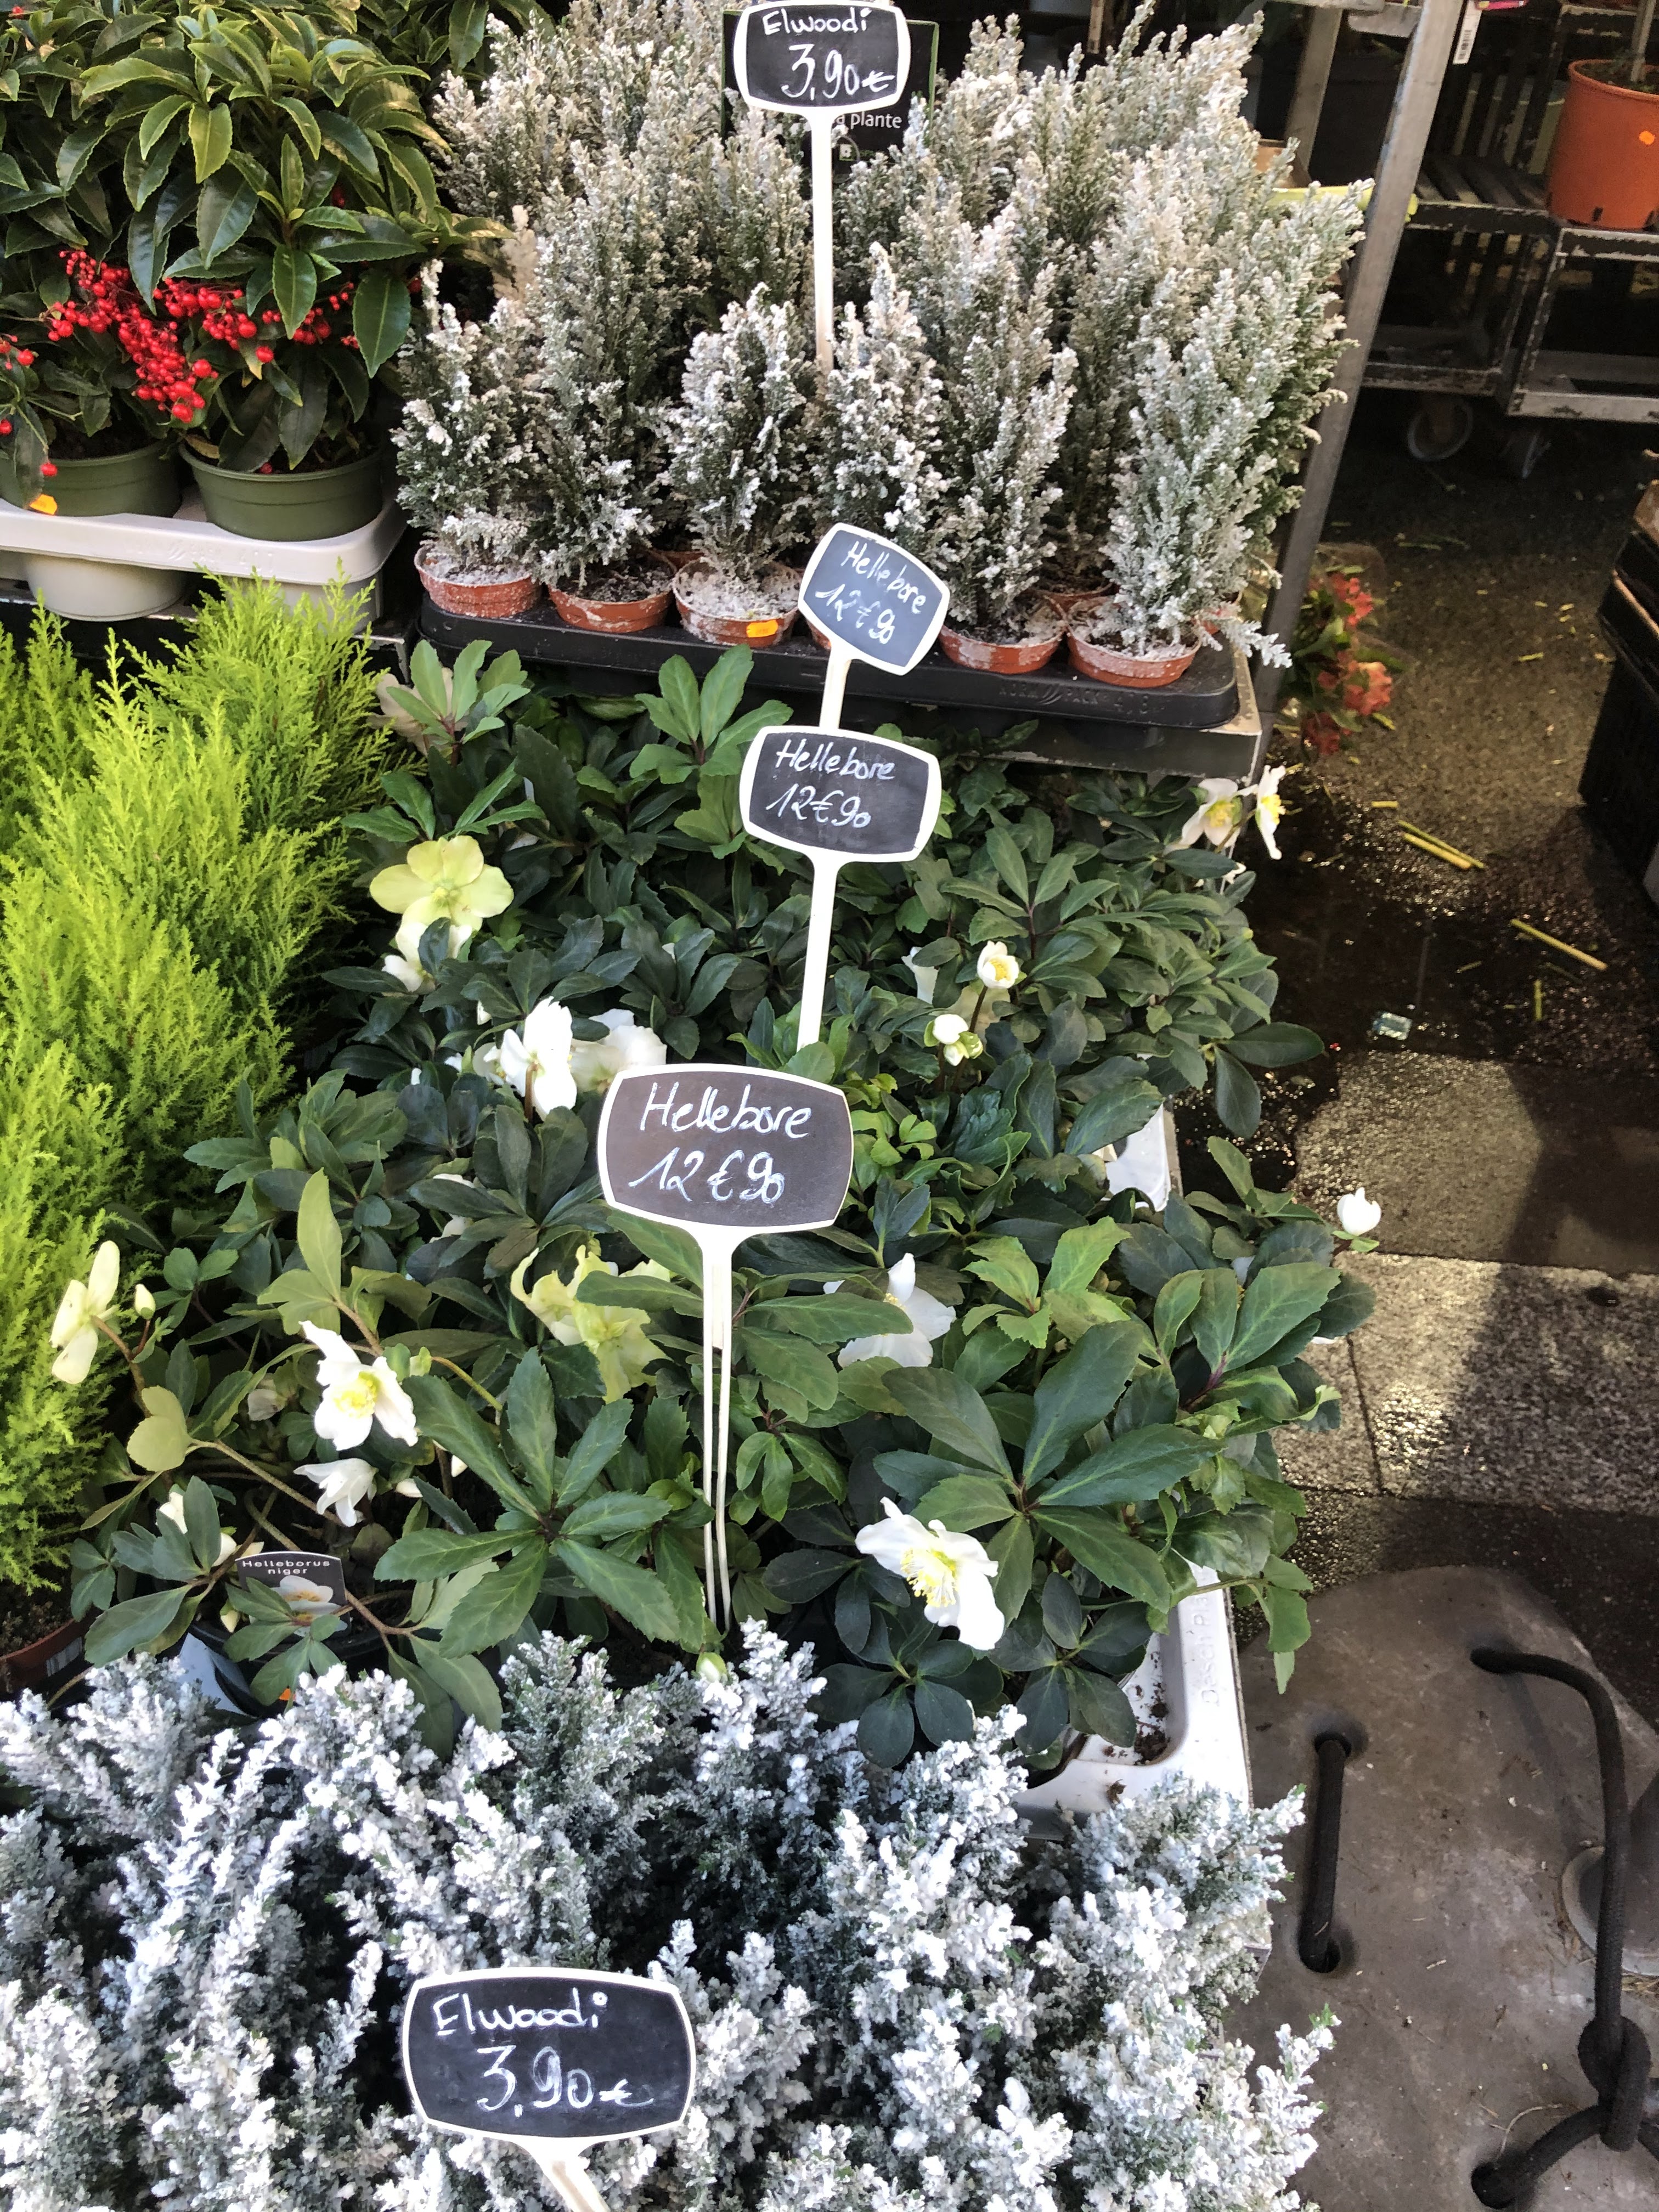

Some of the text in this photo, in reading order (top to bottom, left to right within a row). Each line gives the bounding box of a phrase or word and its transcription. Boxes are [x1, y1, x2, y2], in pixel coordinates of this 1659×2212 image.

[762, 7, 872, 36] Elwoodi
[850, 110, 902, 130] plante
[840, 540, 927, 614] Hellebore
[775, 738, 895, 780] Hellebore
[639, 1080, 812, 1139] Hellebore
[241, 1559, 330, 1568] Helleborus
[267, 1567, 308, 1576] niger
[432, 1987, 609, 2036] Elwoodi
